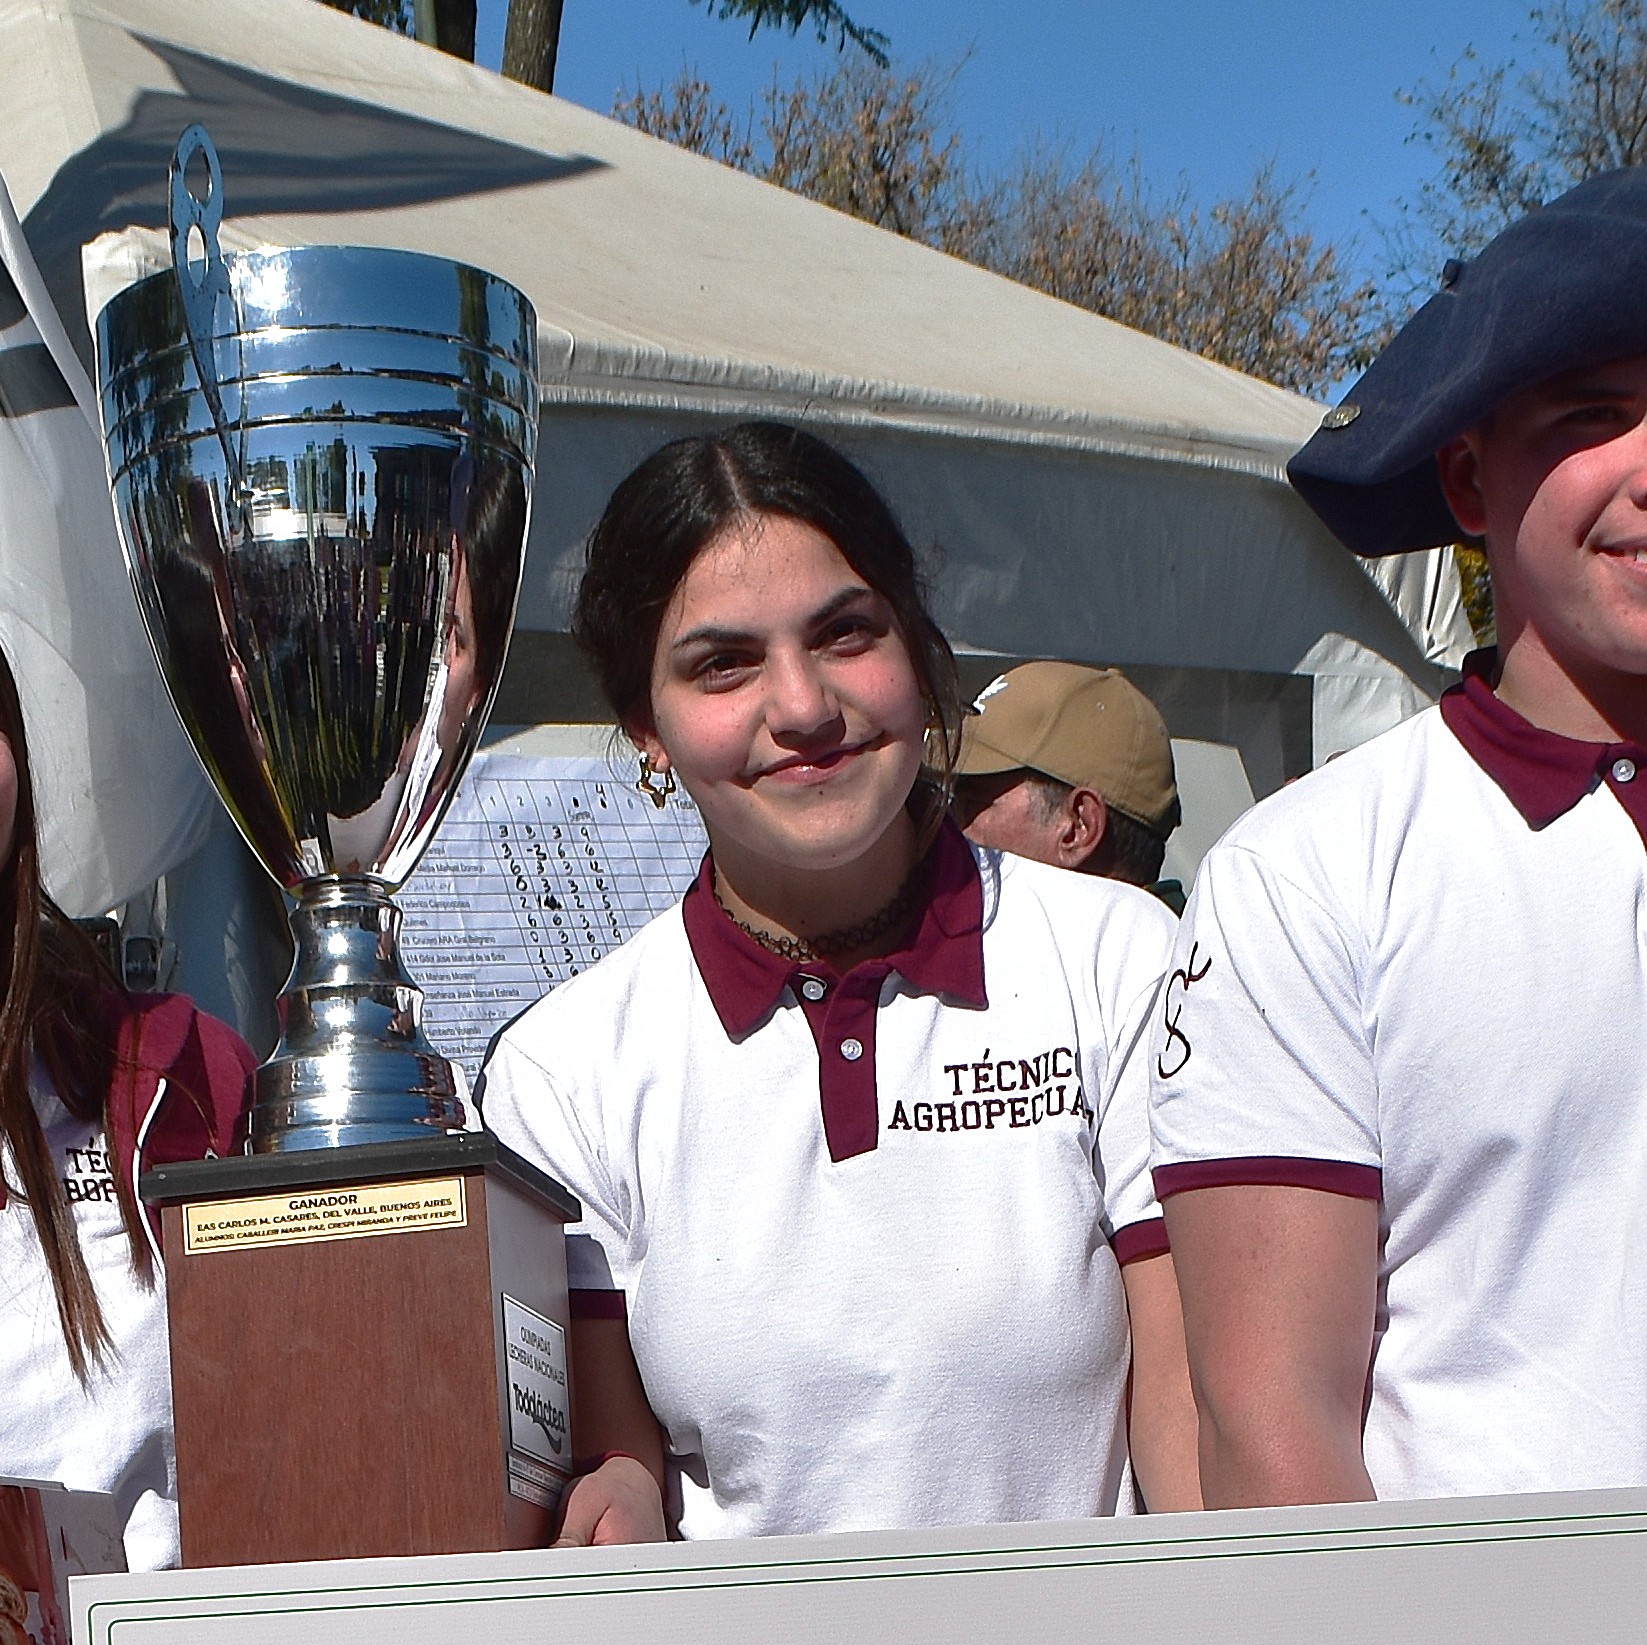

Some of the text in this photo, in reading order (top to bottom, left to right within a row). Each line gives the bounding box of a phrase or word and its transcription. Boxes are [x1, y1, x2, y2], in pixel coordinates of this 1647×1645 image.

[944, 1048, 1083, 1096] TÉCNIC
[887, 1085, 1095, 1132] AGROPECUA
[218, 1218, 257, 1230] CARLOS
[322, 1210, 342, 1219] DEL
[380, 1201, 420, 1213] BUENOS
[289, 1194, 358, 1211] GANADOR
